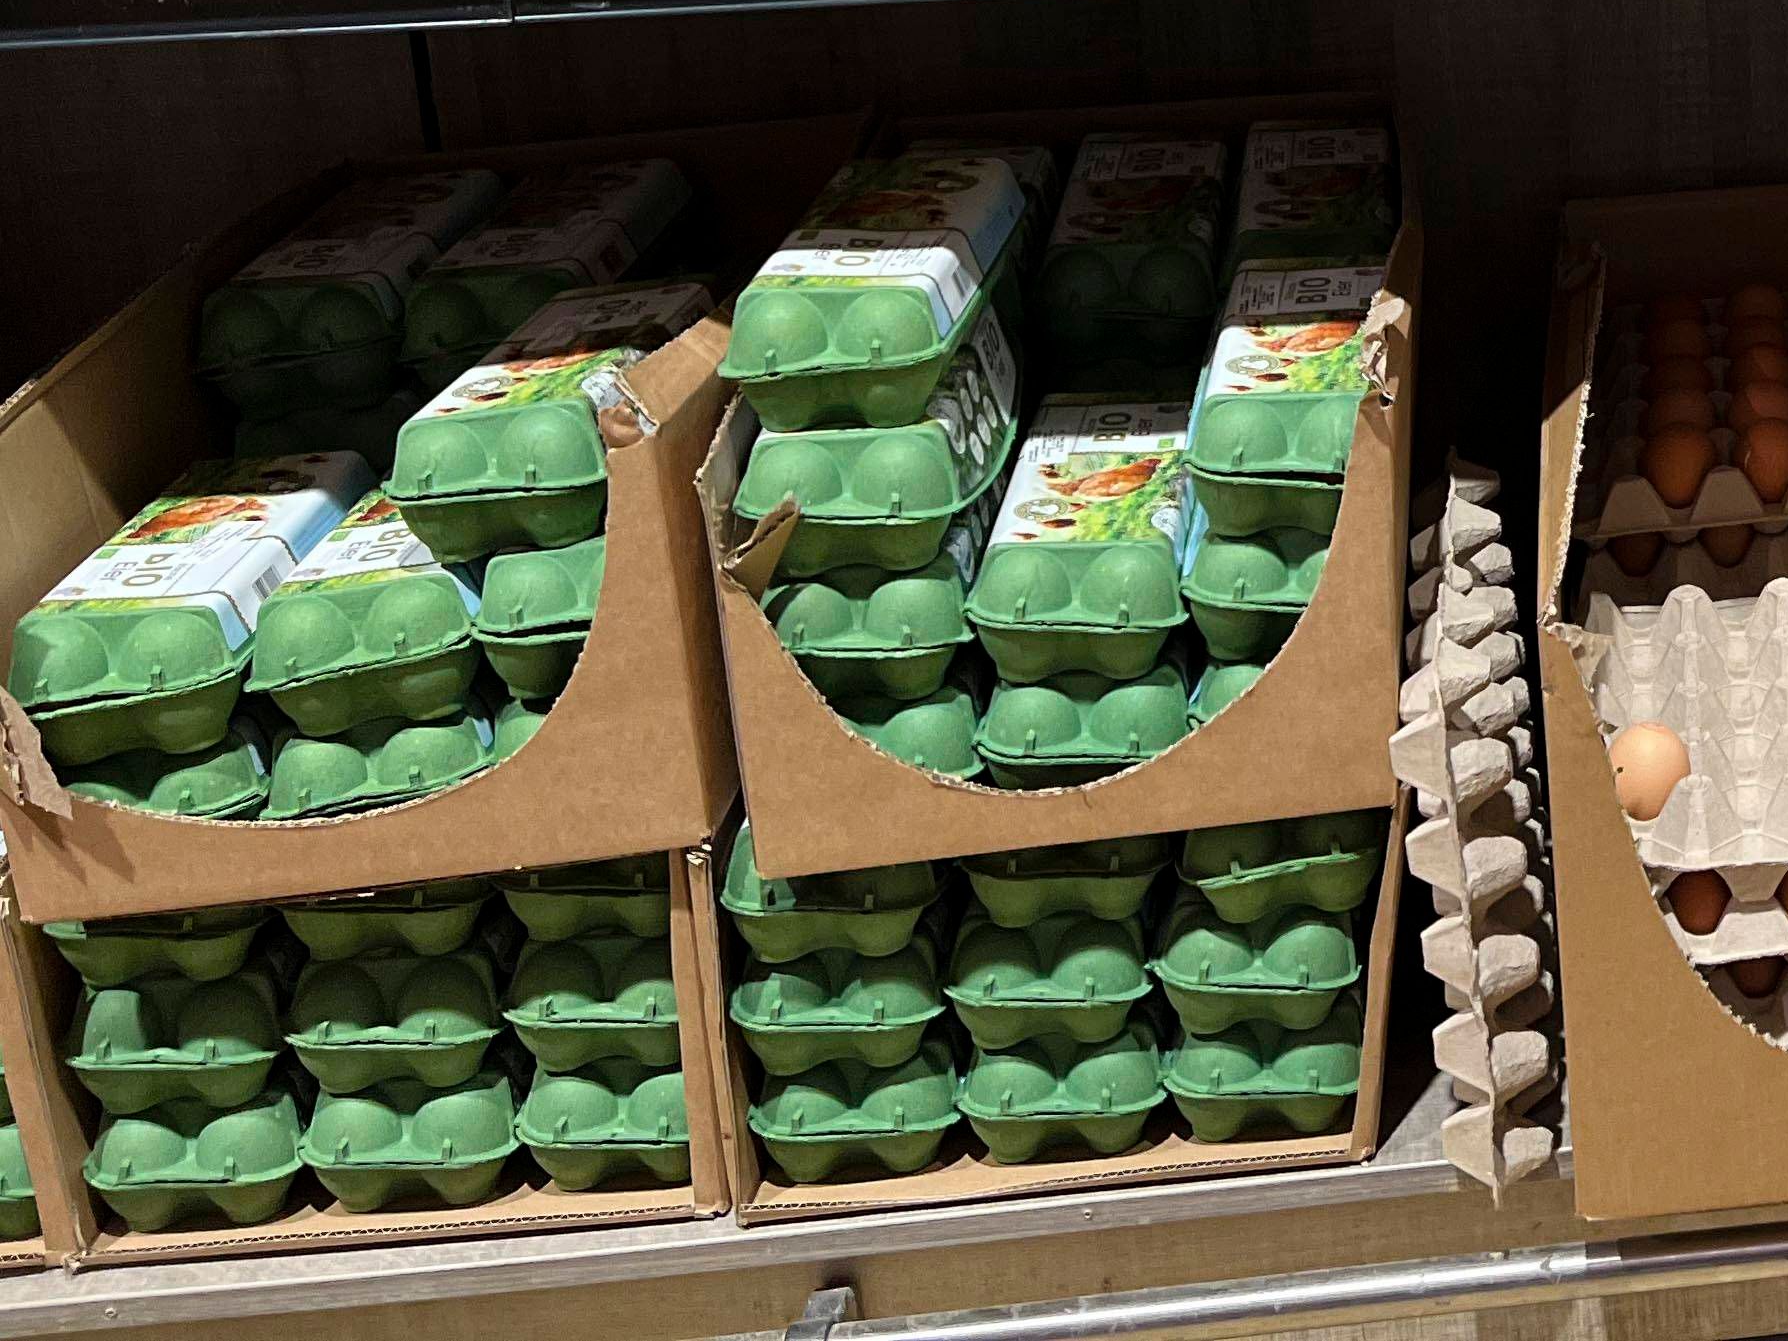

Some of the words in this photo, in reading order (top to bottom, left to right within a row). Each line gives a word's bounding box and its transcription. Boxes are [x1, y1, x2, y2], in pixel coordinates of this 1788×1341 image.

[1295, 277, 1332, 305] BIO
[1332, 280, 1353, 297] Eier
[1093, 412, 1132, 442] BIO
[336, 540, 372, 561] Eier
[358, 528, 412, 562] BIO
[99, 561, 139, 581] Eier
